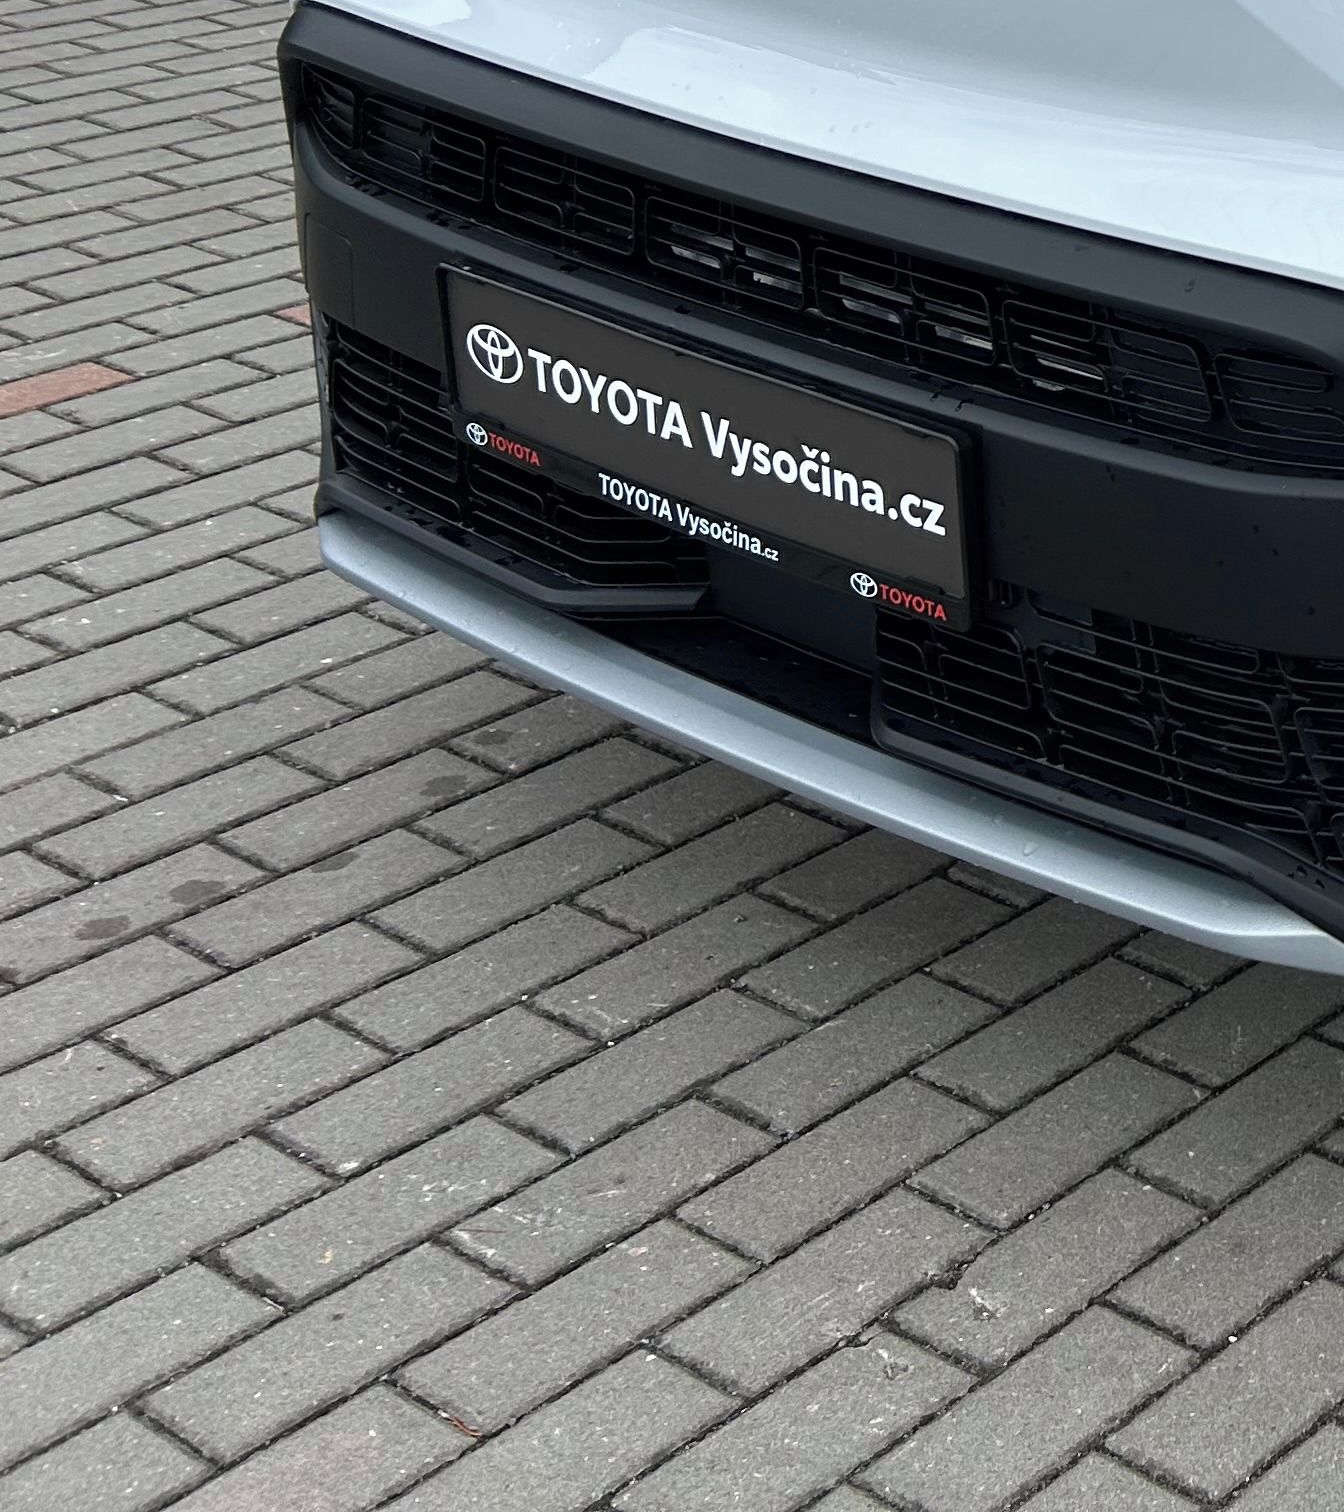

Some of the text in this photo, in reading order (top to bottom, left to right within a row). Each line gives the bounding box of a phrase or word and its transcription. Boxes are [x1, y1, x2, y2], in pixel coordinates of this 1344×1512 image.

[488, 432, 541, 467] TOYOTA
[527, 349, 946, 537] TOYOTA Vysočina.cz
[598, 473, 779, 562] TOYOTA Vysočina.cz
[878, 583, 948, 622] TOYOTA
